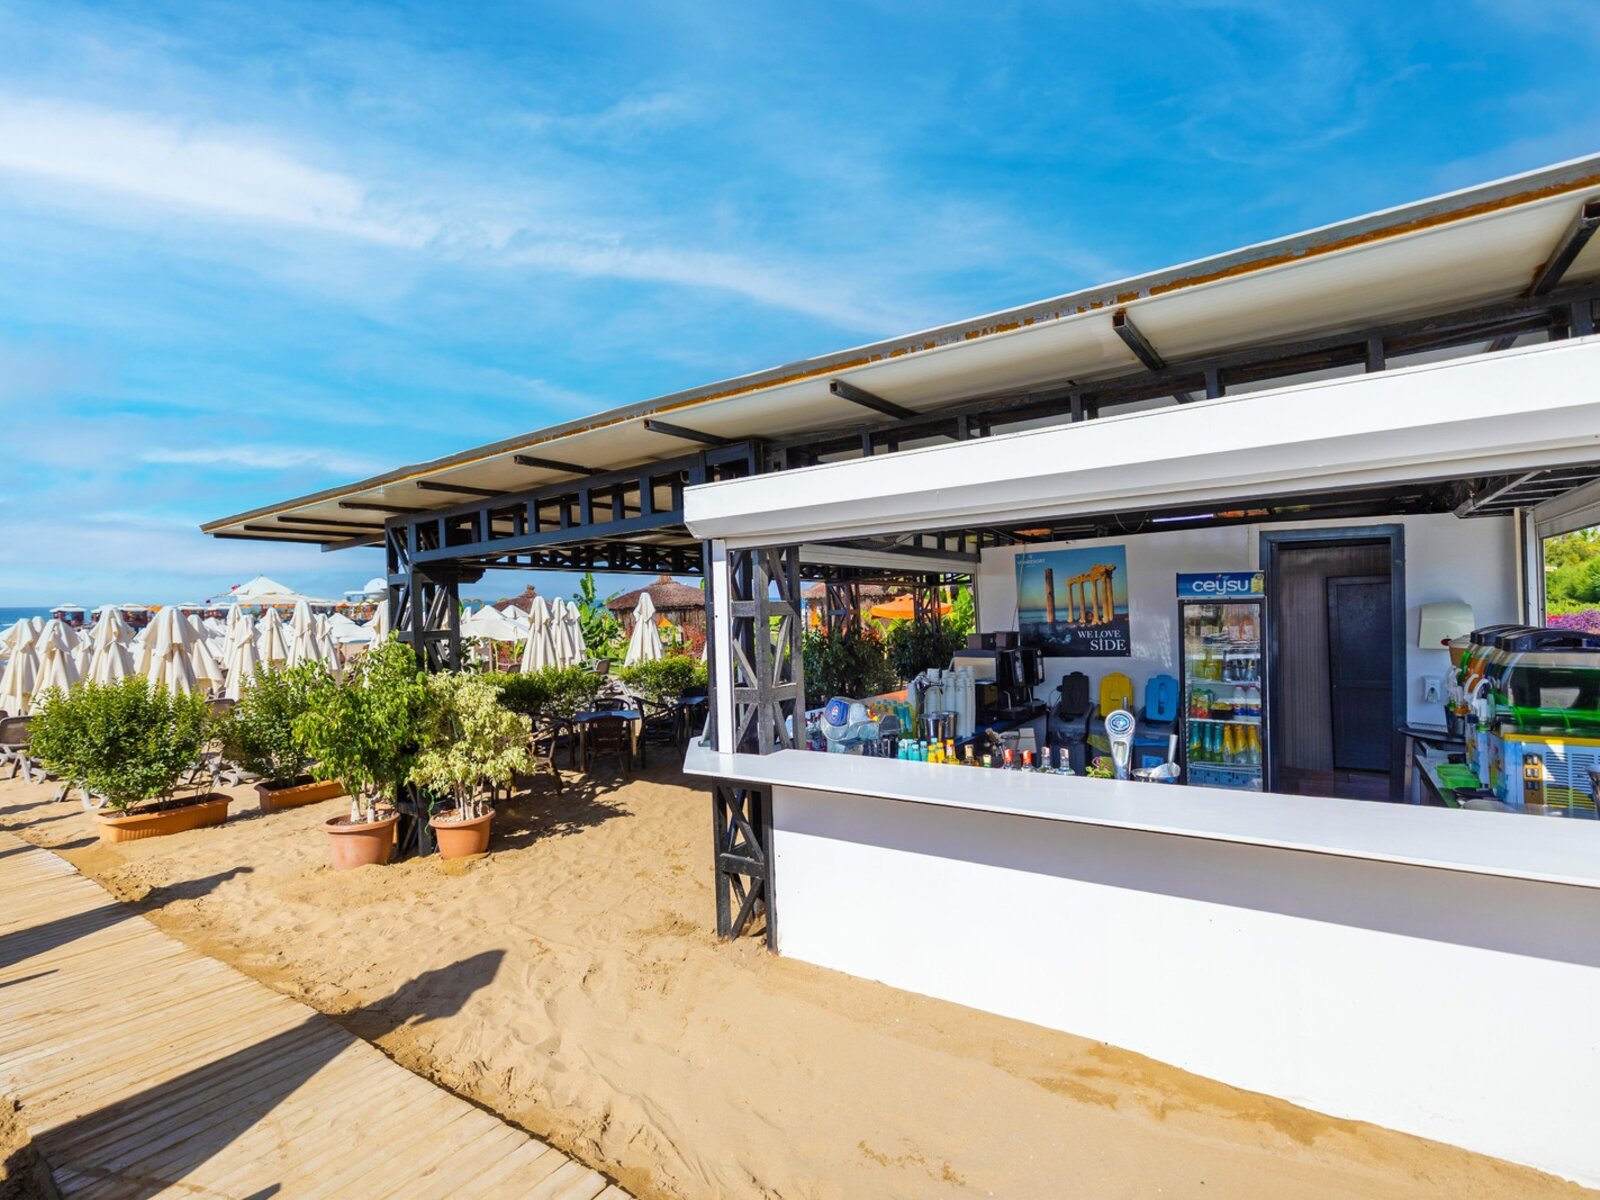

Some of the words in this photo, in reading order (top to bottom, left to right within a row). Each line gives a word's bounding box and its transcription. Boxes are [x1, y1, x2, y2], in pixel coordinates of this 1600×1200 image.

[1192, 578, 1249, 595] ceysu
[1077, 630, 1094, 639] WE
[1094, 629, 1121, 639] LOVE
